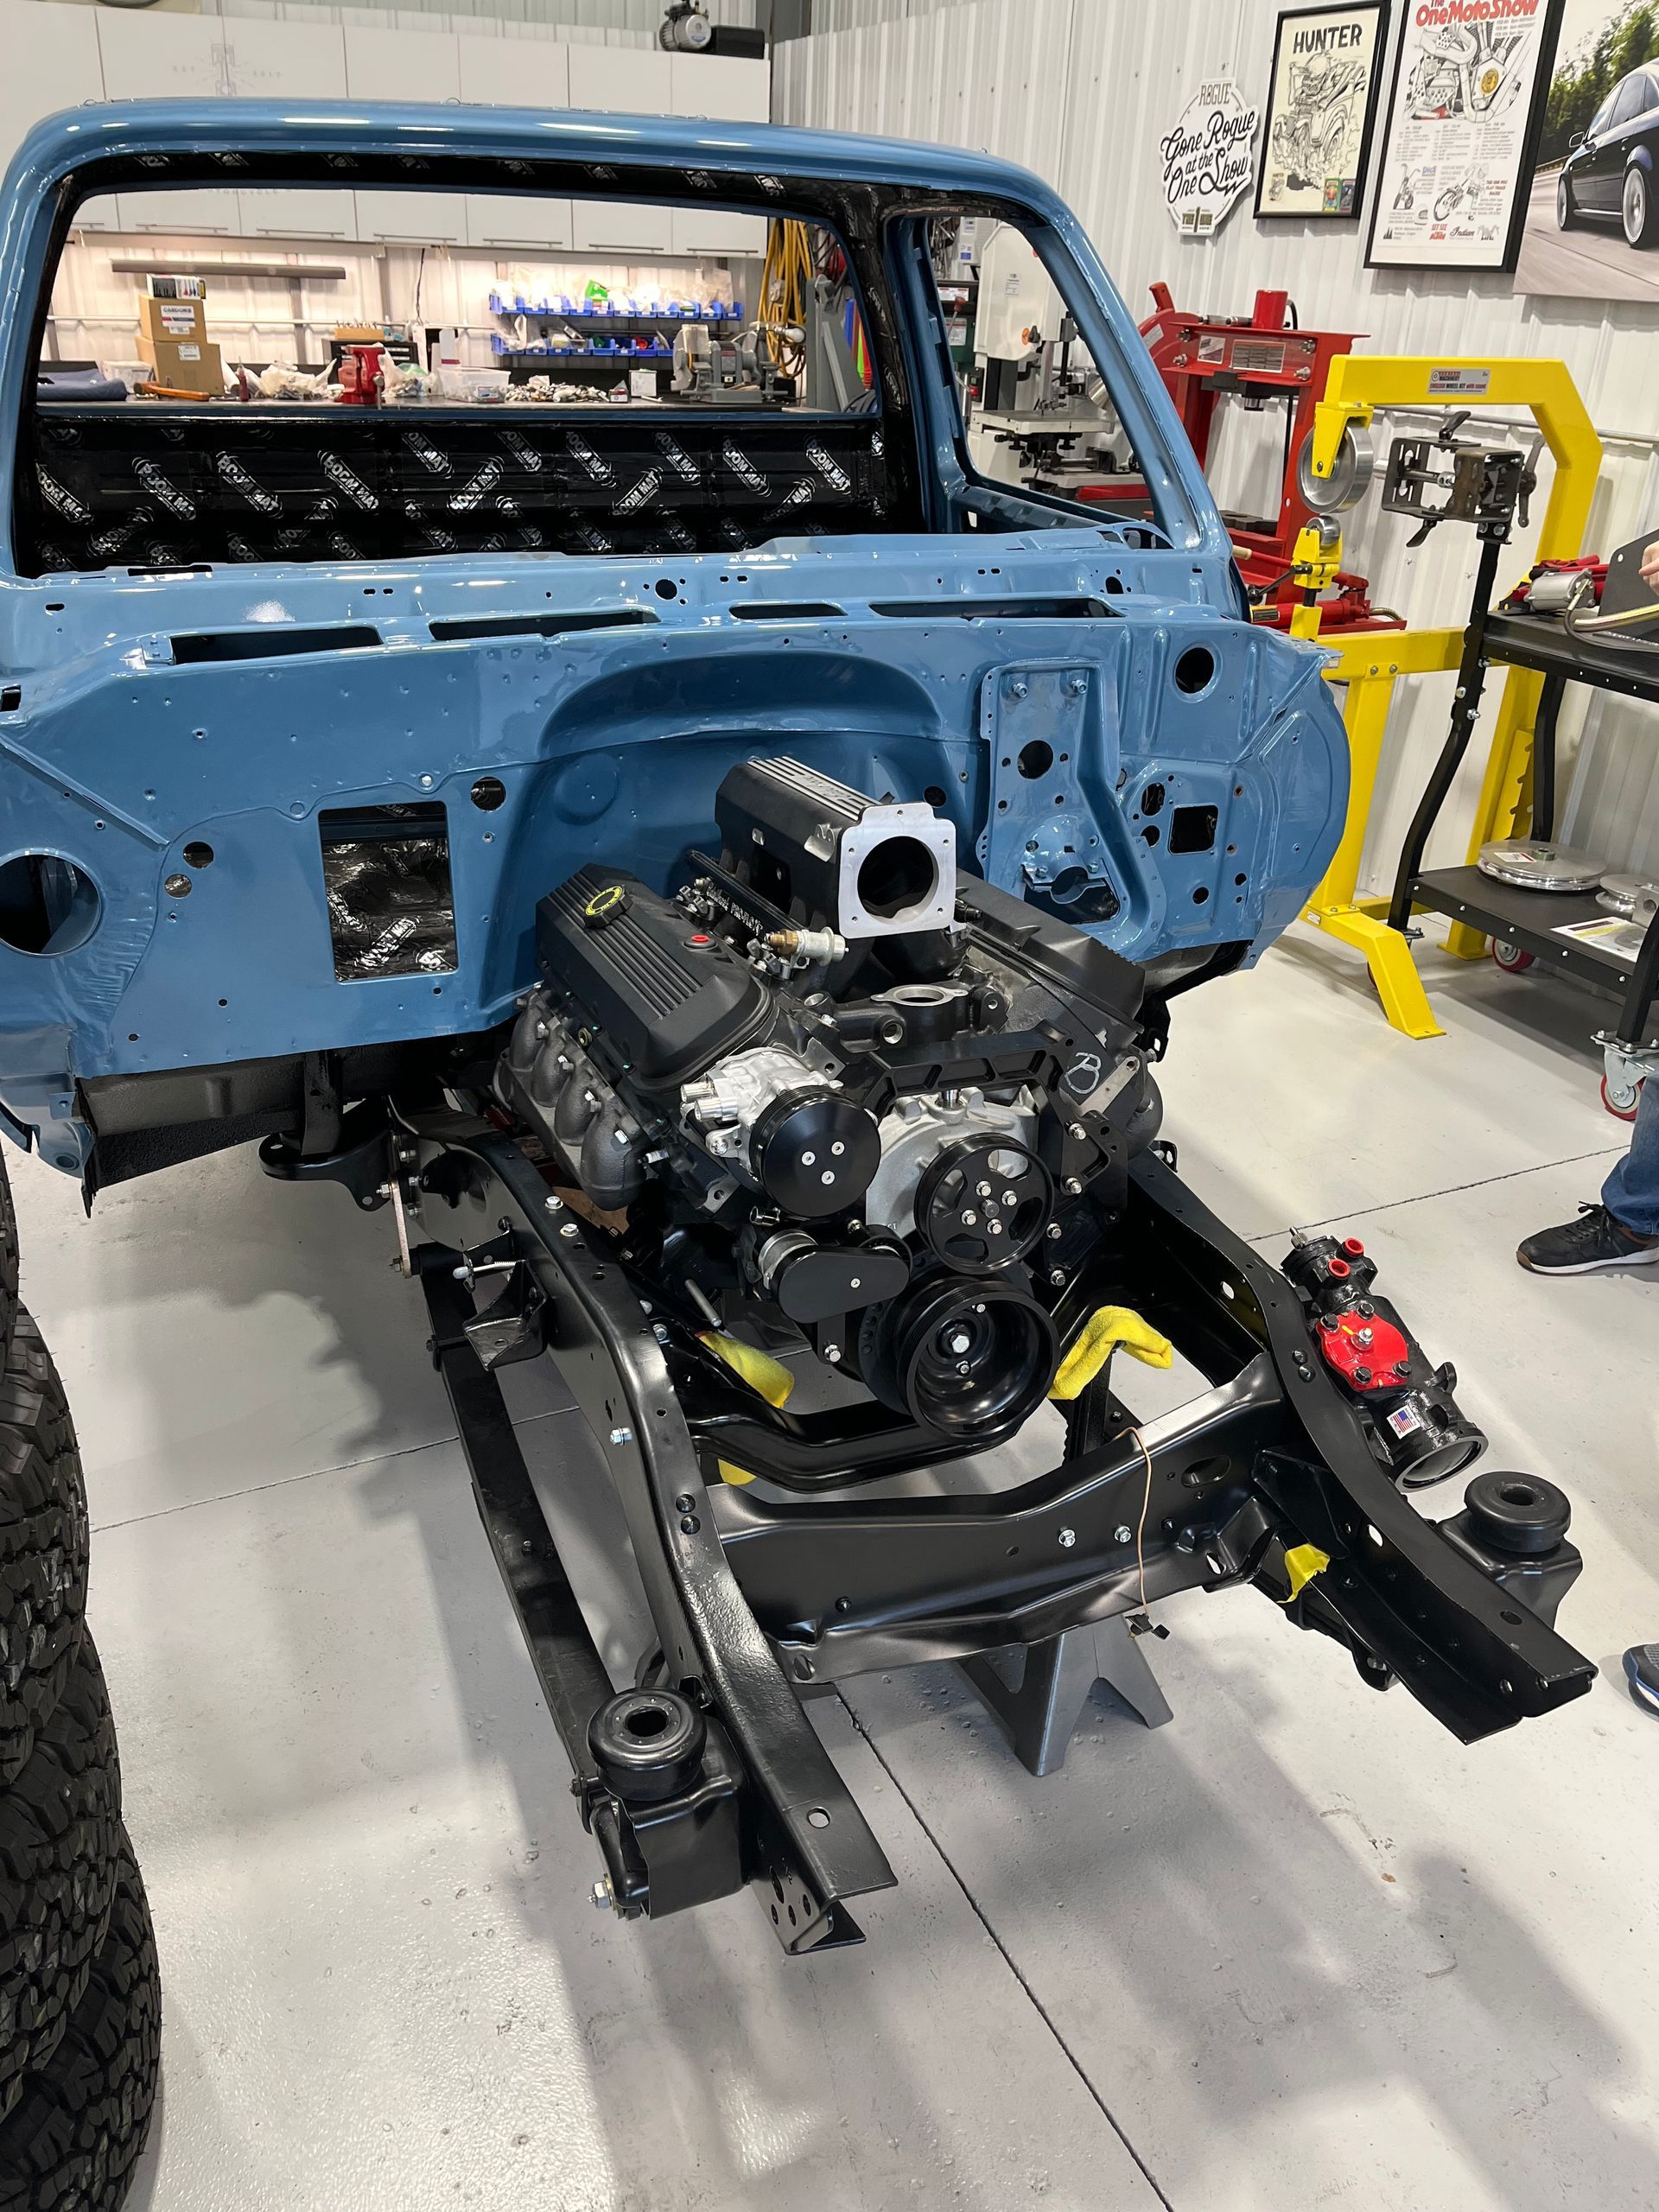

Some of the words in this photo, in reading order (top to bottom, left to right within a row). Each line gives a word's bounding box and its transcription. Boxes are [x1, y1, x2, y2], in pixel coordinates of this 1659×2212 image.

[1293, 23, 1363, 54] HUNTER
[1198, 83, 1231, 106] ROGUE
[1160, 126, 1202, 181] Gone
[1204, 110, 1255, 152] Rogue
[1168, 167, 1198, 204] One
[1198, 147, 1249, 197] Show
[1185, 155, 1198, 175] at
[1198, 151, 1214, 171] the
[1450, 226, 1475, 237] Indian
[217, 454, 254, 493] BOOM
[323, 454, 359, 490] BOOM
[639, 469, 660, 495] MAT
